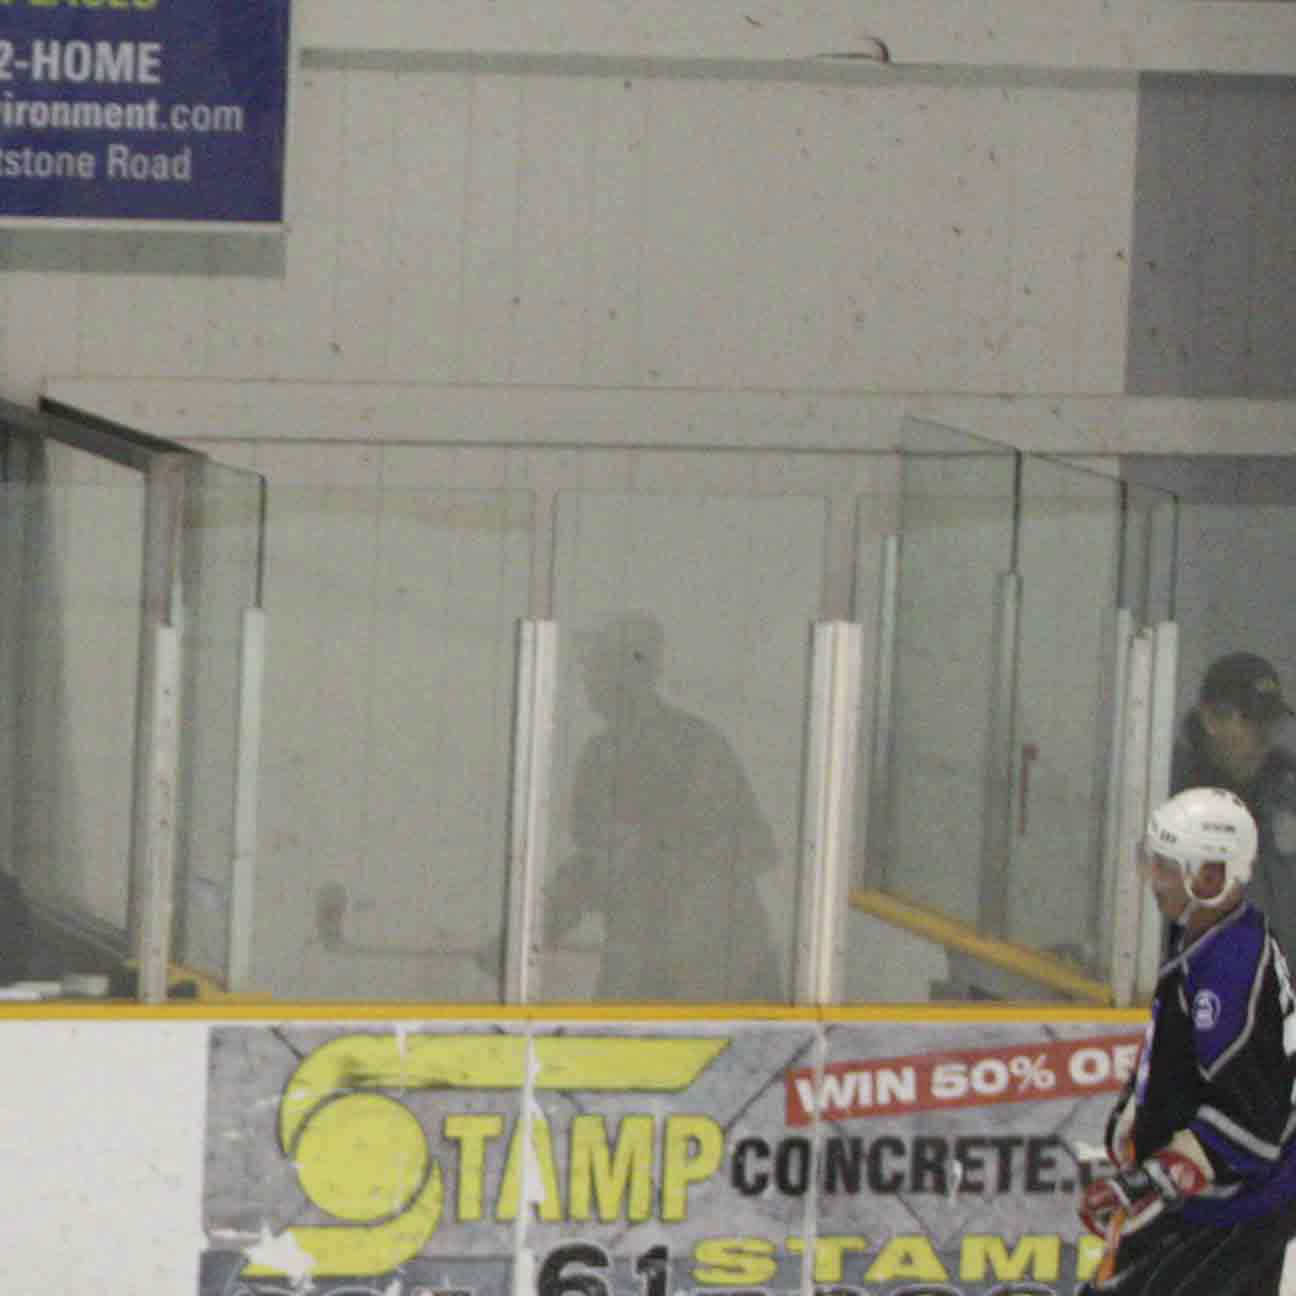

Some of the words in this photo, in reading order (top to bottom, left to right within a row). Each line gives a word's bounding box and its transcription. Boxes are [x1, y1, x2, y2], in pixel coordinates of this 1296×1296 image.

[108, 144, 193, 181] Road
[795, 1065, 916, 1113] WIN
[931, 1054, 1056, 1098] 50%
